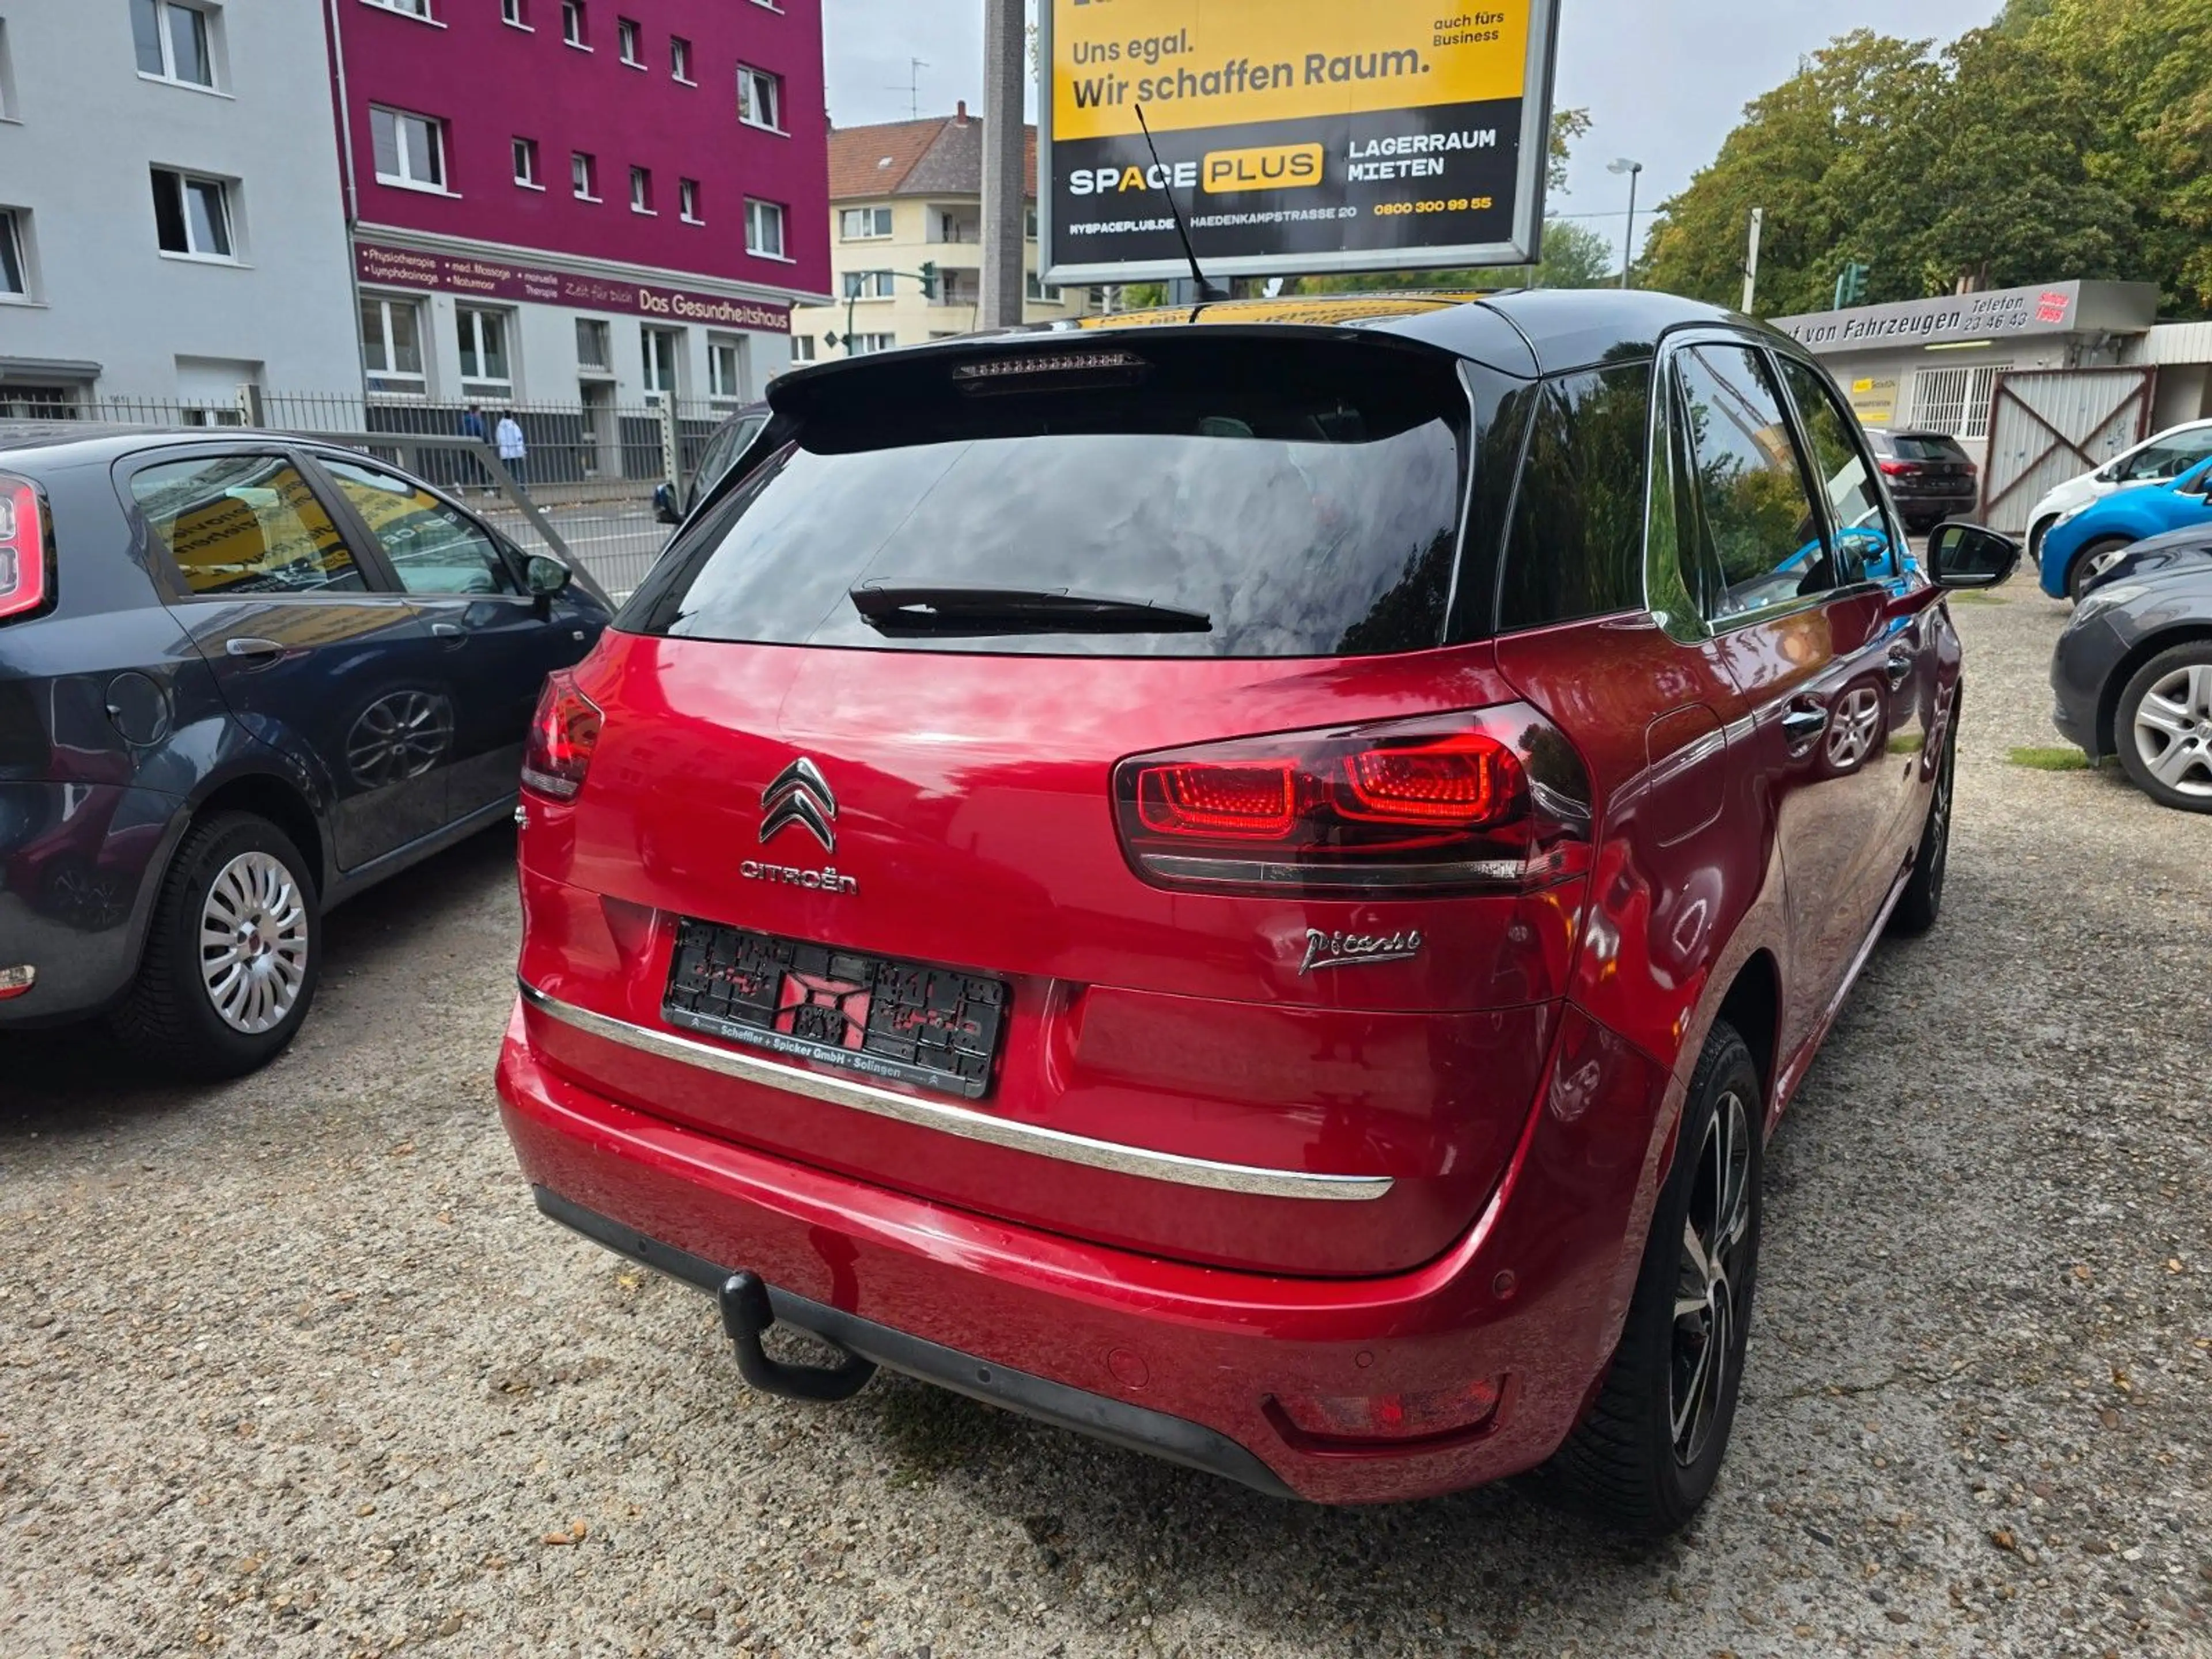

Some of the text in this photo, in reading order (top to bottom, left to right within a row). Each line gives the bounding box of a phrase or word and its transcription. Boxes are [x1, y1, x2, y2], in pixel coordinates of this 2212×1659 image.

[1433, 12, 1504, 31] auch fürs
[1433, 28, 1499, 47] Business
[1073, 28, 1194, 65] Uns egal.
[1073, 48, 1430, 108] Wir schaffen Raum.
[1349, 128, 1496, 159] LAGERRAUM
[1070, 153, 1315, 195] SPACE PLUS
[1347, 157, 1445, 181] MIETEN
[1069, 196, 1493, 235] MYSPACEPLUS.DE HAEDENKAMPSTRASSE 20 0800 300 99 55
[639, 288, 788, 329] Das Gesundheitshaus
[1972, 295, 2025, 315] Telefon
[1805, 324, 1838, 344] von
[1843, 310, 1961, 342] Fahrzeugen
[1963, 312, 2028, 334] 23 46 43
[1298, 927, 1421, 976] Picasso
[773, 1037, 812, 1056] Spicker
[813, 1047, 845, 1065] GmbH
[853, 1056, 902, 1078] Solingen
